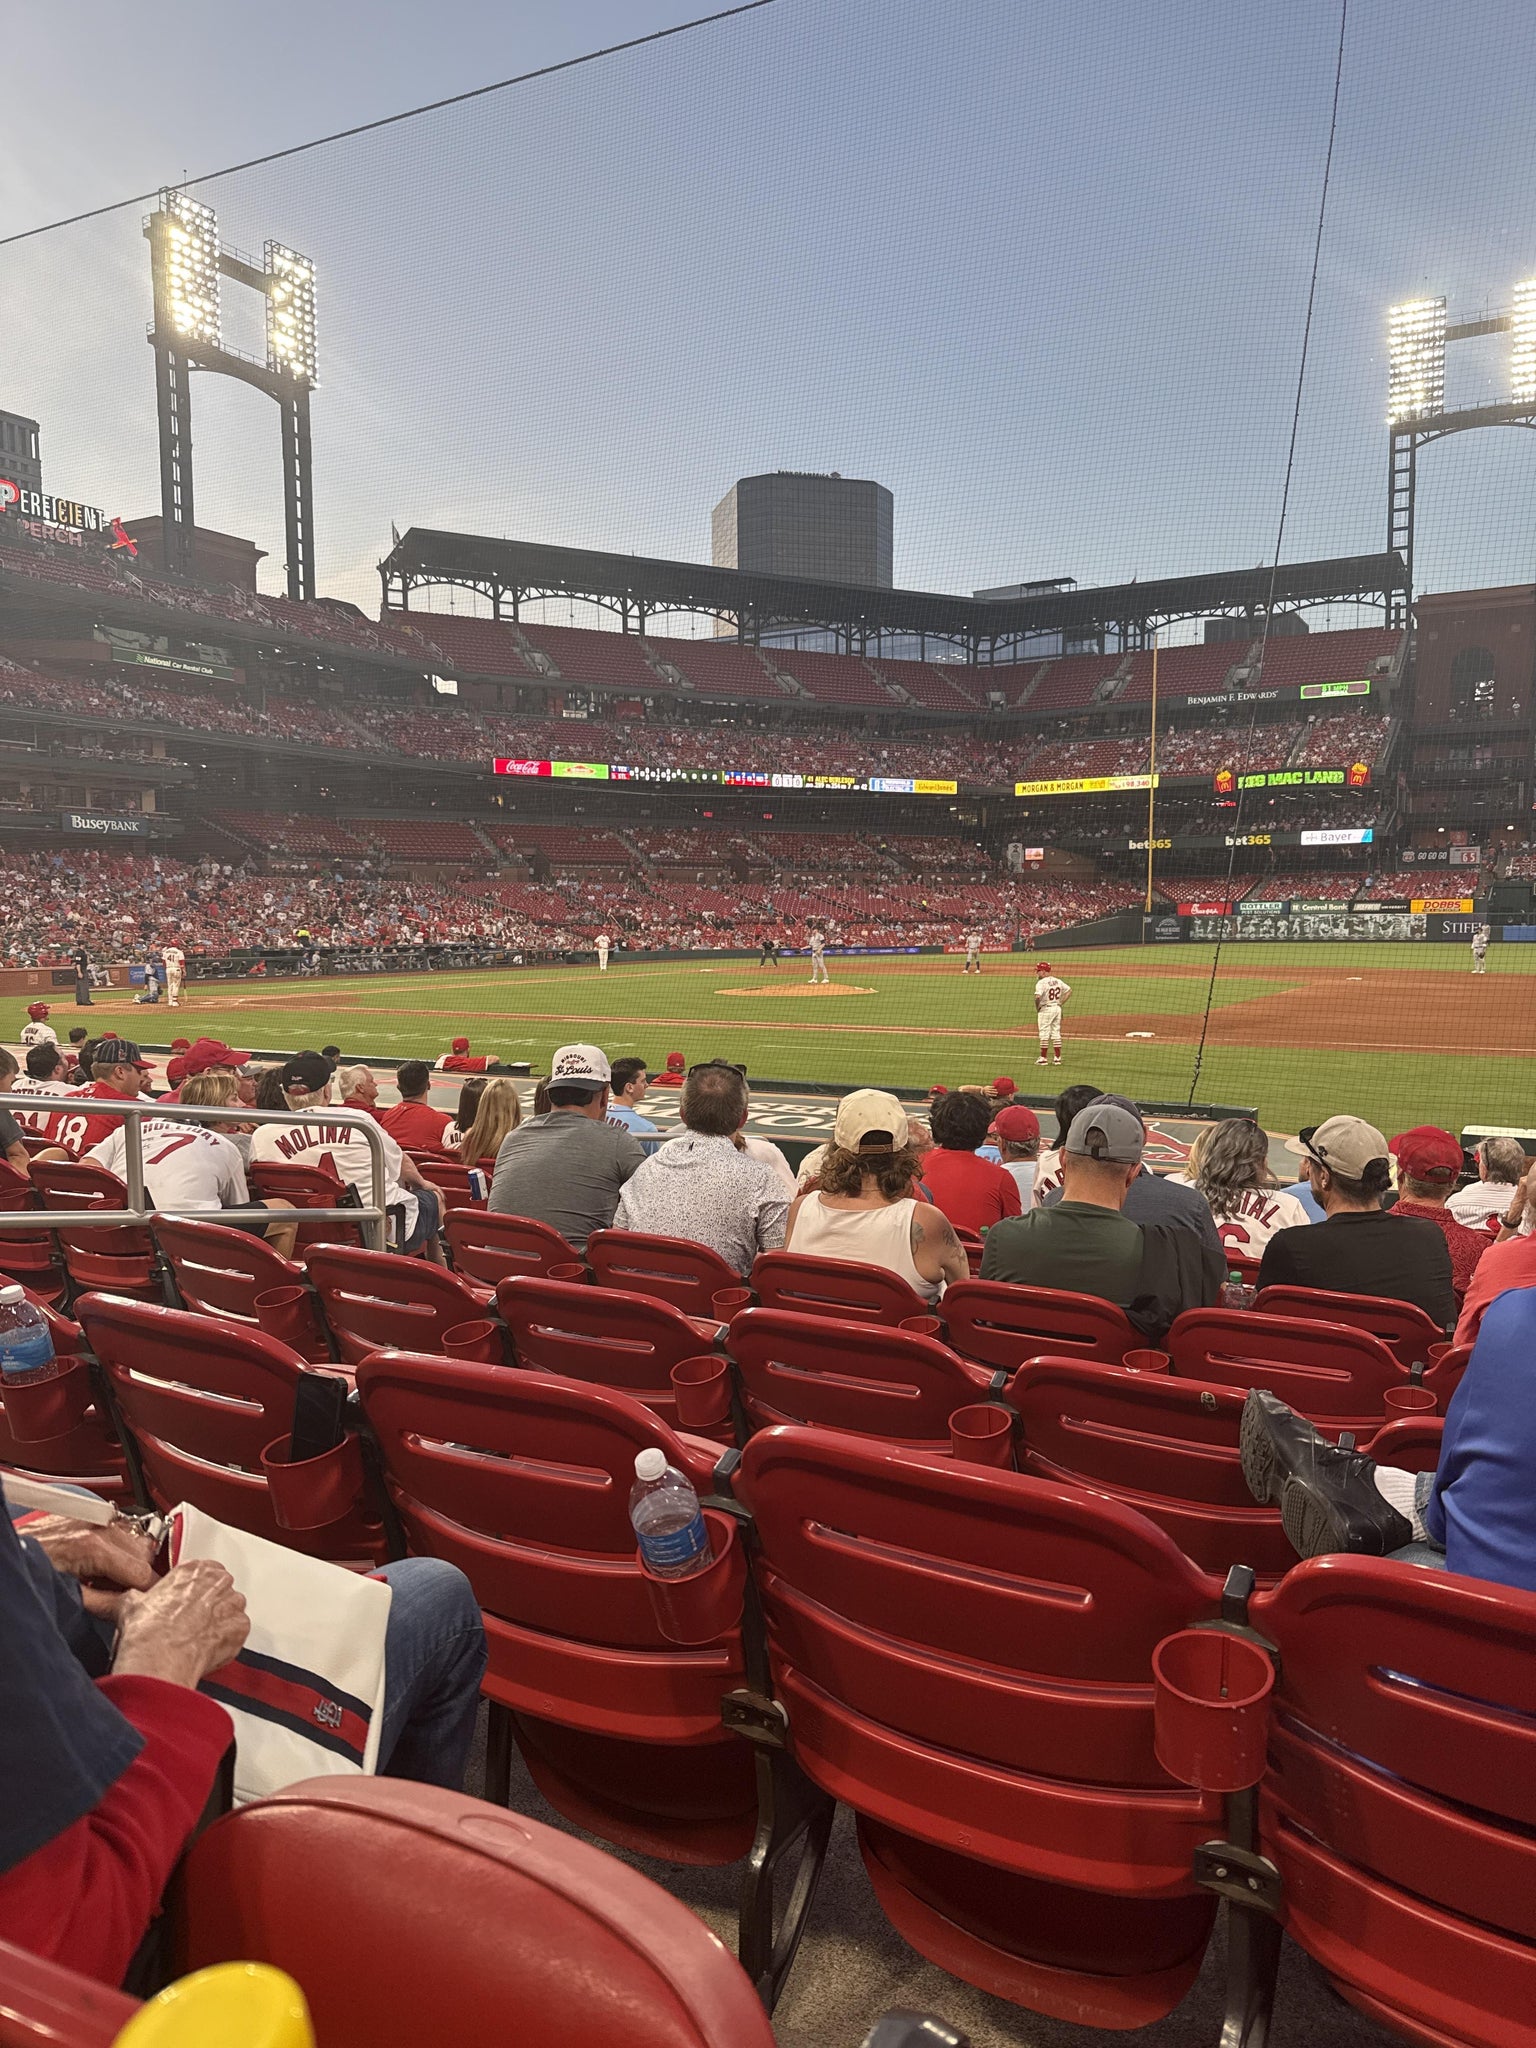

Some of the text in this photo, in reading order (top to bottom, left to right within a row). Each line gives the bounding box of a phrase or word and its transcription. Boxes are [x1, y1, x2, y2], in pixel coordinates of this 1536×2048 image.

[144, 656, 171, 668] National
[1187, 695, 1228, 705] BENJAMIN
[1267, 772, 1303, 786] MAC
[1304, 770, 1344, 784] LAND
[1022, 784, 1048, 793] MORGAN
[1056, 782, 1084, 791] MORGAN
[1225, 834, 1272, 846] bet365
[1320, 831, 1352, 842] Bayer
[1128, 838, 1172, 850] bet365
[1302, 903, 1328, 911] Central
[1423, 901, 1462, 909] DOBBS
[1049, 987, 1060, 1000] 82
[563, 1065, 593, 1076] Louis
[55, 1114, 88, 1153] 18
[146, 1132, 197, 1165] 7
[274, 1125, 351, 1160] MOLINA
